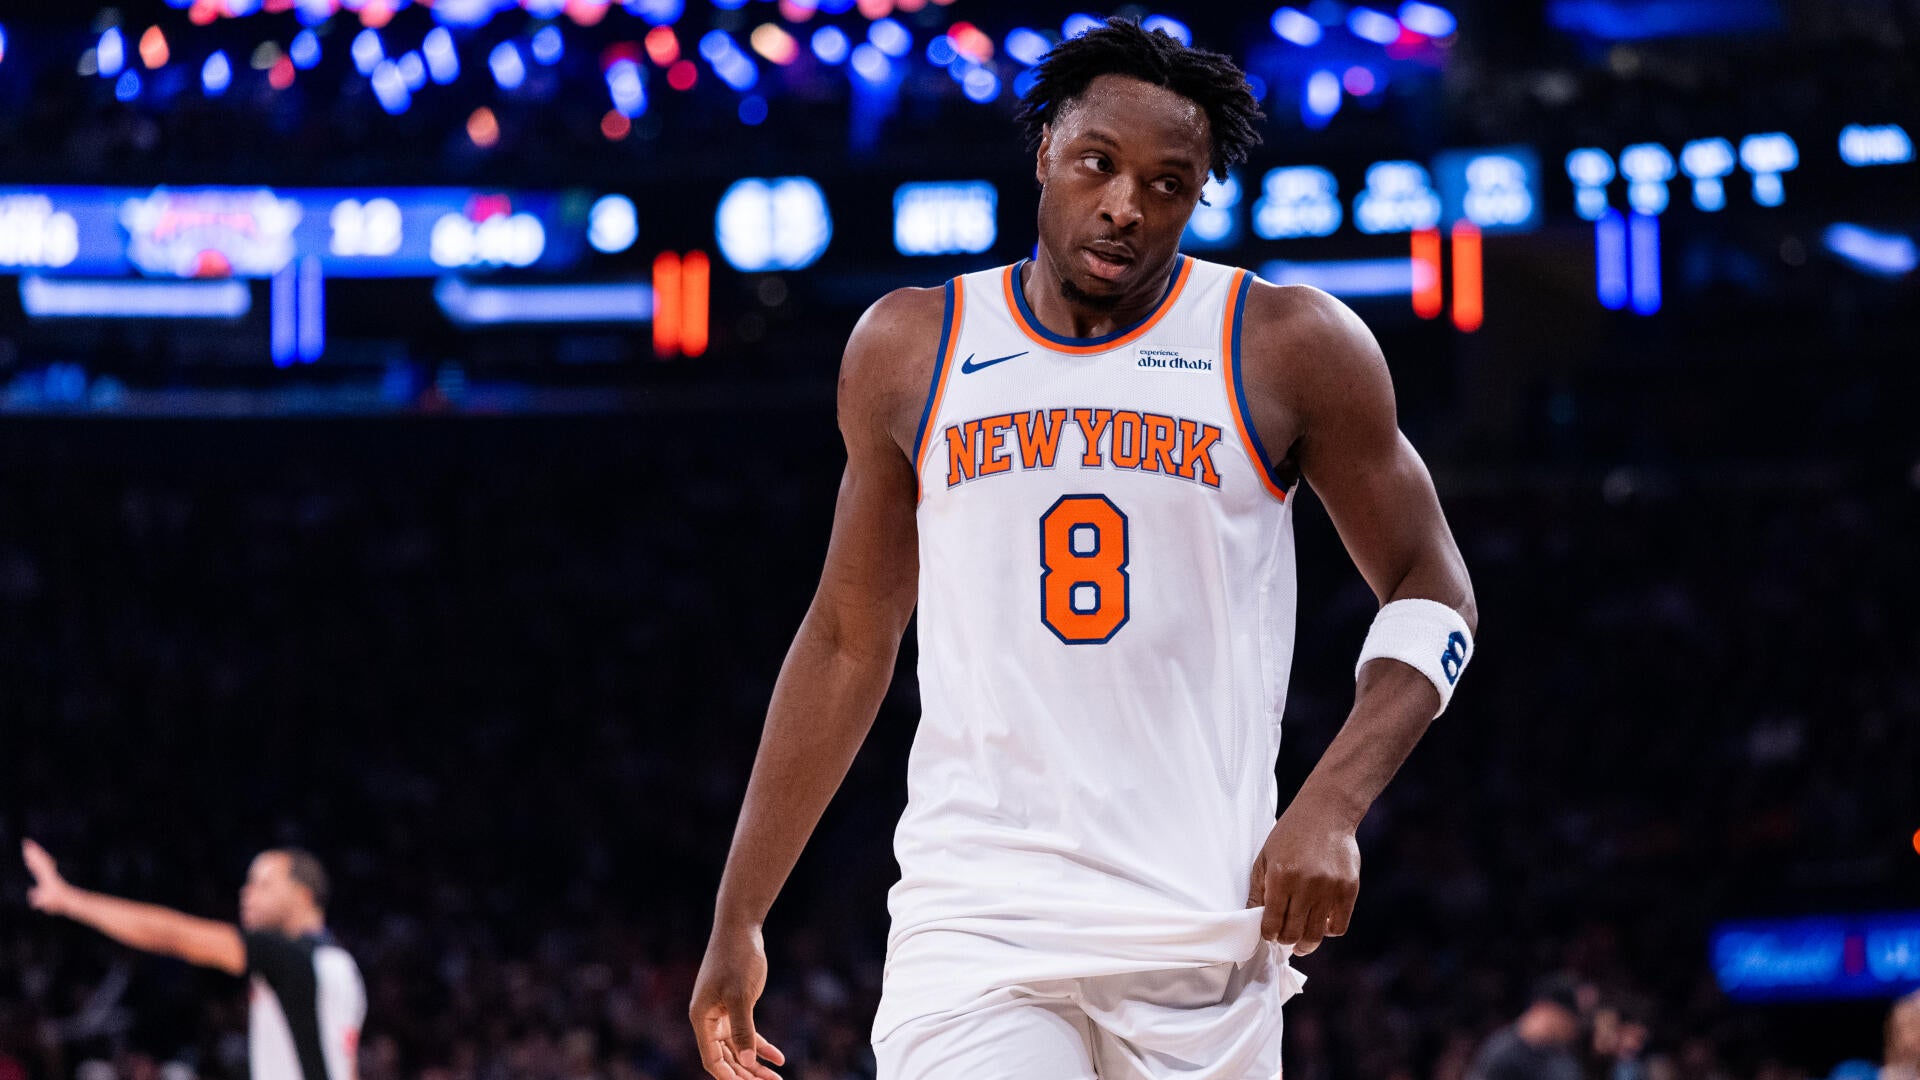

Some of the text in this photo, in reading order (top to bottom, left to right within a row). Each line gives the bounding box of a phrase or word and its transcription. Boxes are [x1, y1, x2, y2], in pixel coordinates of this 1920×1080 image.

[1138, 356, 1212, 371] abu dhabi
[1140, 349, 1179, 357] experience
[946, 408, 1223, 490] NEW YORK
[1040, 494, 1130, 645] 8
[1441, 631, 1467, 686] 8
